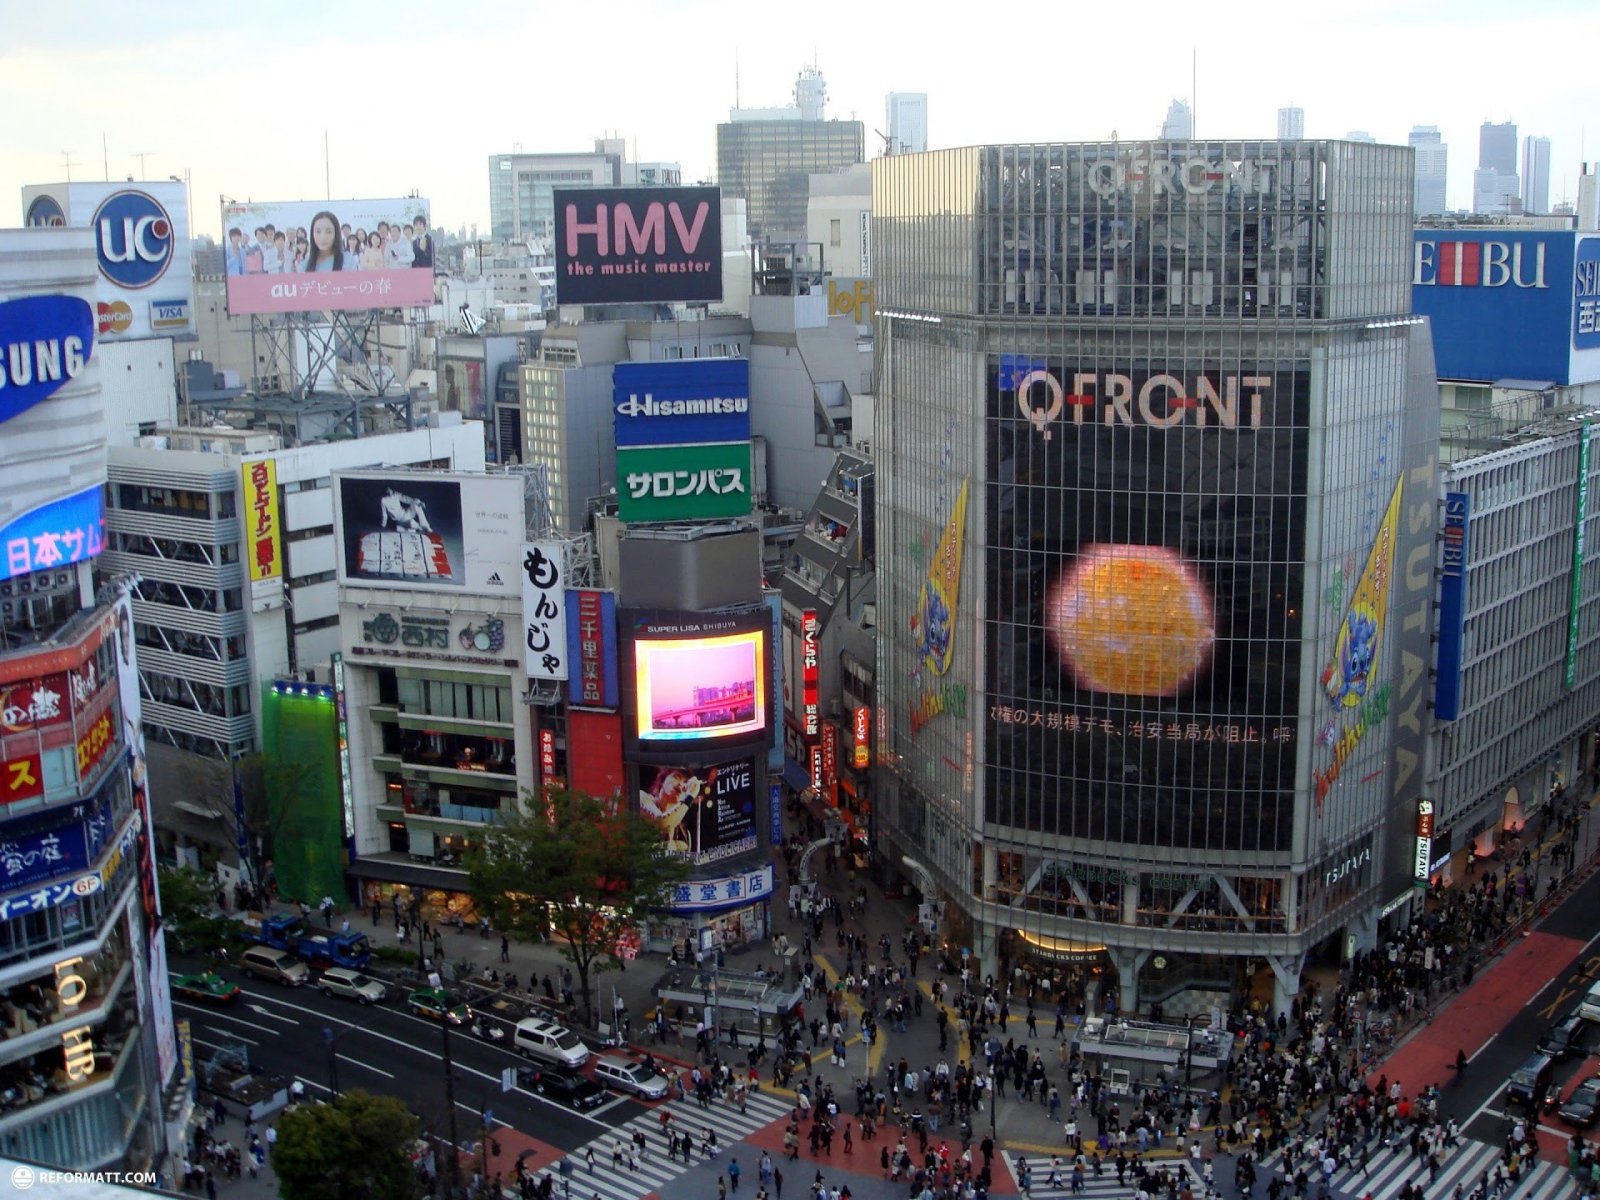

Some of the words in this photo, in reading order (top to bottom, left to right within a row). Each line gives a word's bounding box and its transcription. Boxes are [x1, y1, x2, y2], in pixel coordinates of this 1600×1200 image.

[100, 216, 171, 264] UC
[565, 201, 710, 257] HMV
[567, 261, 594, 276] the
[601, 260, 647, 275] music
[655, 259, 711, 274] master
[98, 311, 133, 324] sterCard
[158, 306, 183, 319] VISA
[617, 394, 749, 418] Hisamitsu
[1017, 370, 1272, 440] QFRONT
[627, 468, 745, 499] サロンパス
[1443, 500, 1465, 577] SEIBU
[523, 547, 560, 675] もんじゃ
[1394, 454, 1435, 797] TSUTAYA
[401, 624, 450, 649] 西村
[648, 625, 678, 633] SUPER
[680, 624, 700, 632] LISA
[703, 621, 736, 630] SHIBUYA
[580, 596, 601, 701] 三千里薬品
[717, 772, 750, 796] LIVE
[1418, 837, 1428, 878] TSUTAYA
[77, 878, 96, 892] 6F
[658, 874, 763, 903] 盛堂書店
[1046, 863, 1140, 886] STARBUCKS
[1150, 877, 1212, 892] COFFEE
